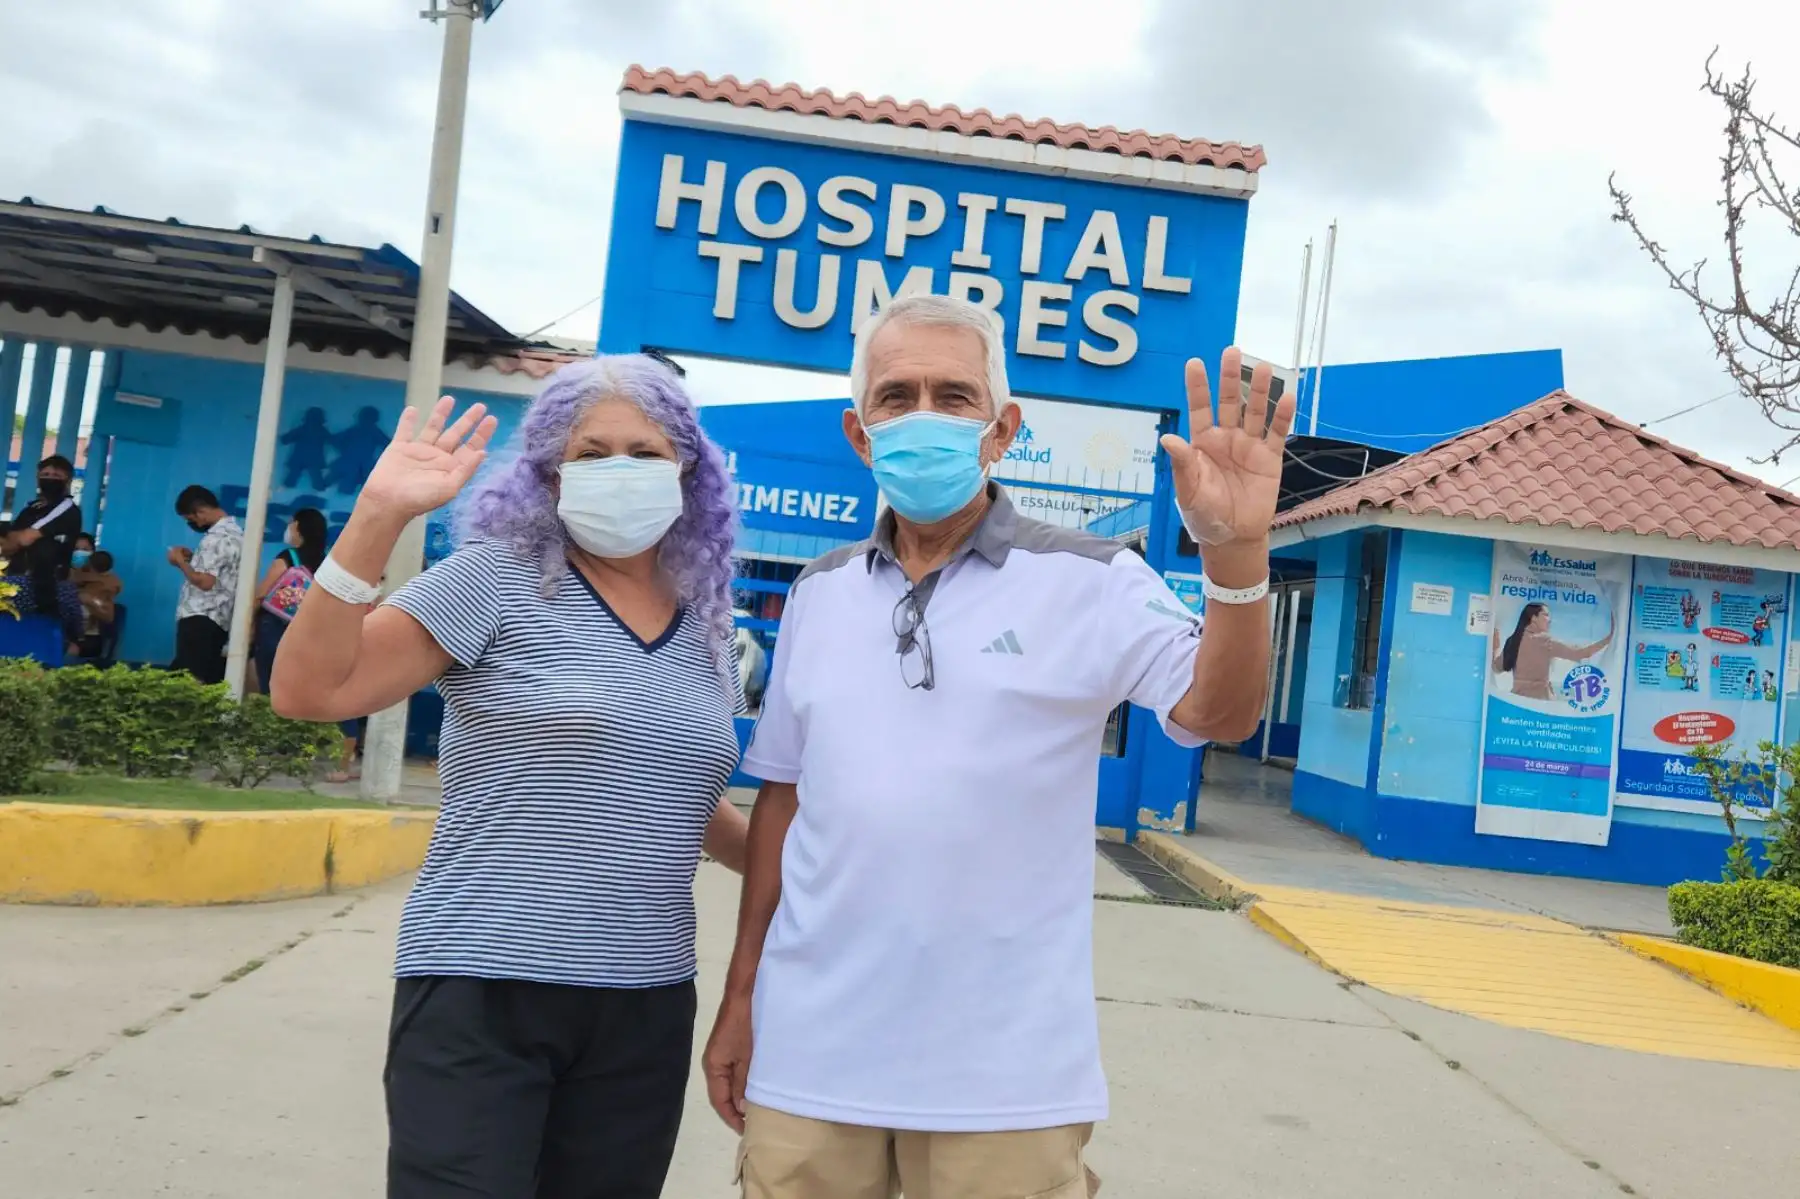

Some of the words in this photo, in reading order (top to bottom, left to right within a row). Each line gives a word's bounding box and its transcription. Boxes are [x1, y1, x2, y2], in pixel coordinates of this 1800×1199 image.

[656, 154, 1192, 293] HOSPITAL
[698, 240, 1140, 366] TUMBES
[1003, 447, 1051, 464] Salud
[741, 483, 859, 523] IMENEZ
[1554, 558, 1596, 571] EsSalud
[1502, 573, 1523, 582] Abre
[1501, 584, 1557, 601] respira
[1636, 643, 1644, 653] 2
[1712, 655, 1720, 668] 4
[1570, 675, 1602, 702] TB
[1526, 729, 1571, 740] ventilados
[1551, 722, 1597, 734] ambientes
[1522, 739, 1533, 748] LA
[1525, 760, 1534, 768] 24
[1535, 761, 1545, 769] de
[1546, 763, 1569, 772] marzo
[1625, 779, 1674, 793] Seguridad
[1678, 785, 1707, 796] Social
